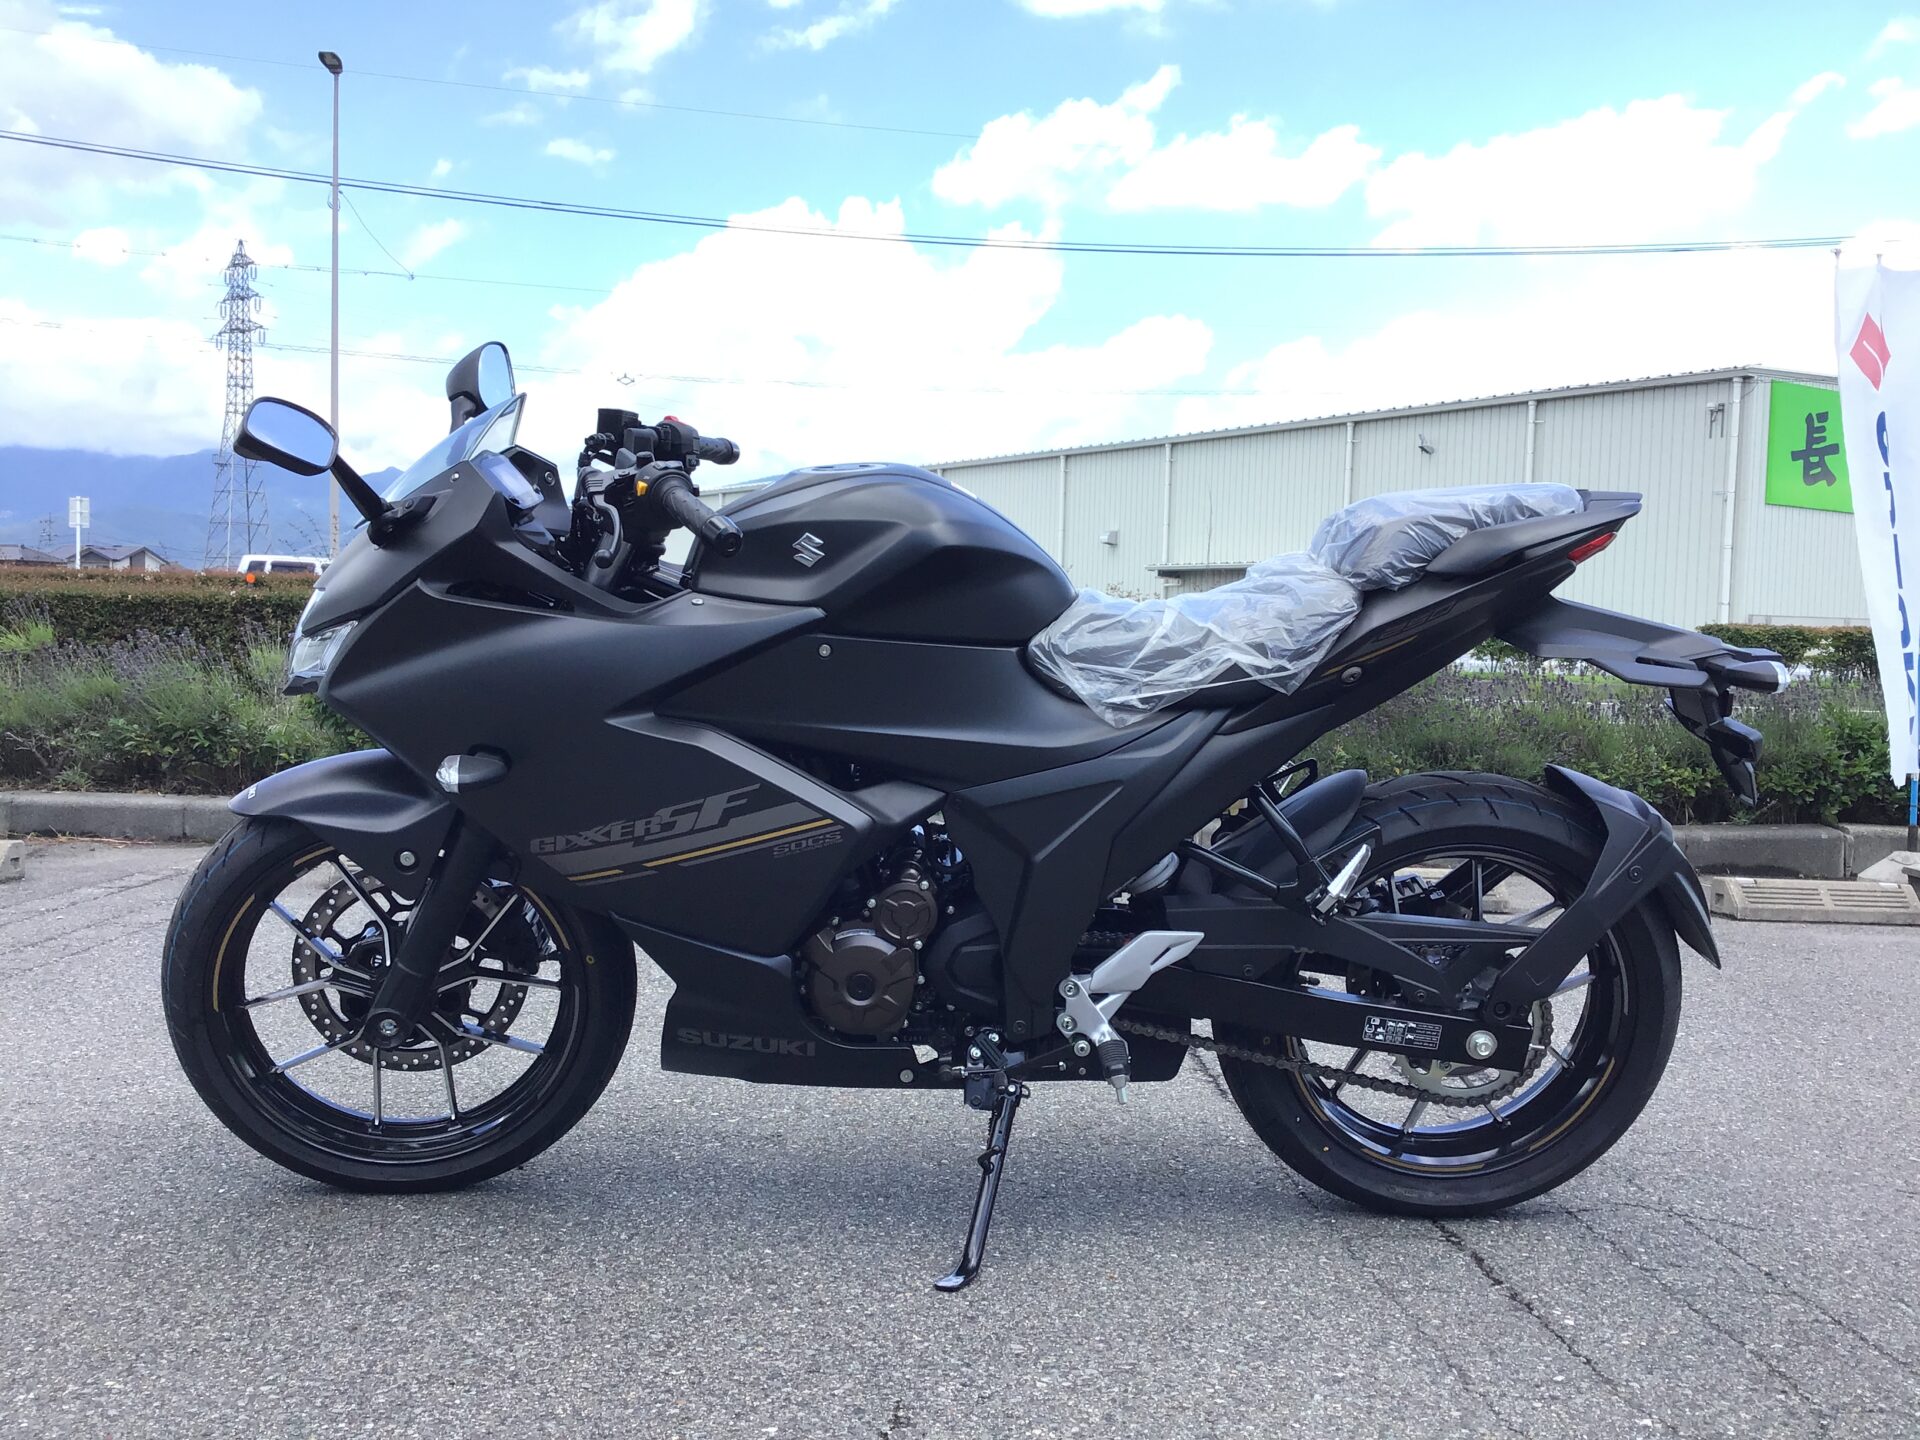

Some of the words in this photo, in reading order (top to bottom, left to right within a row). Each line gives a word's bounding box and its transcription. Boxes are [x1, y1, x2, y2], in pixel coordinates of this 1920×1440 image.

[1790, 411, 1840, 487] 長
[772, 831, 843, 857] SOCS
[676, 1027, 816, 1057] SUZUKI
